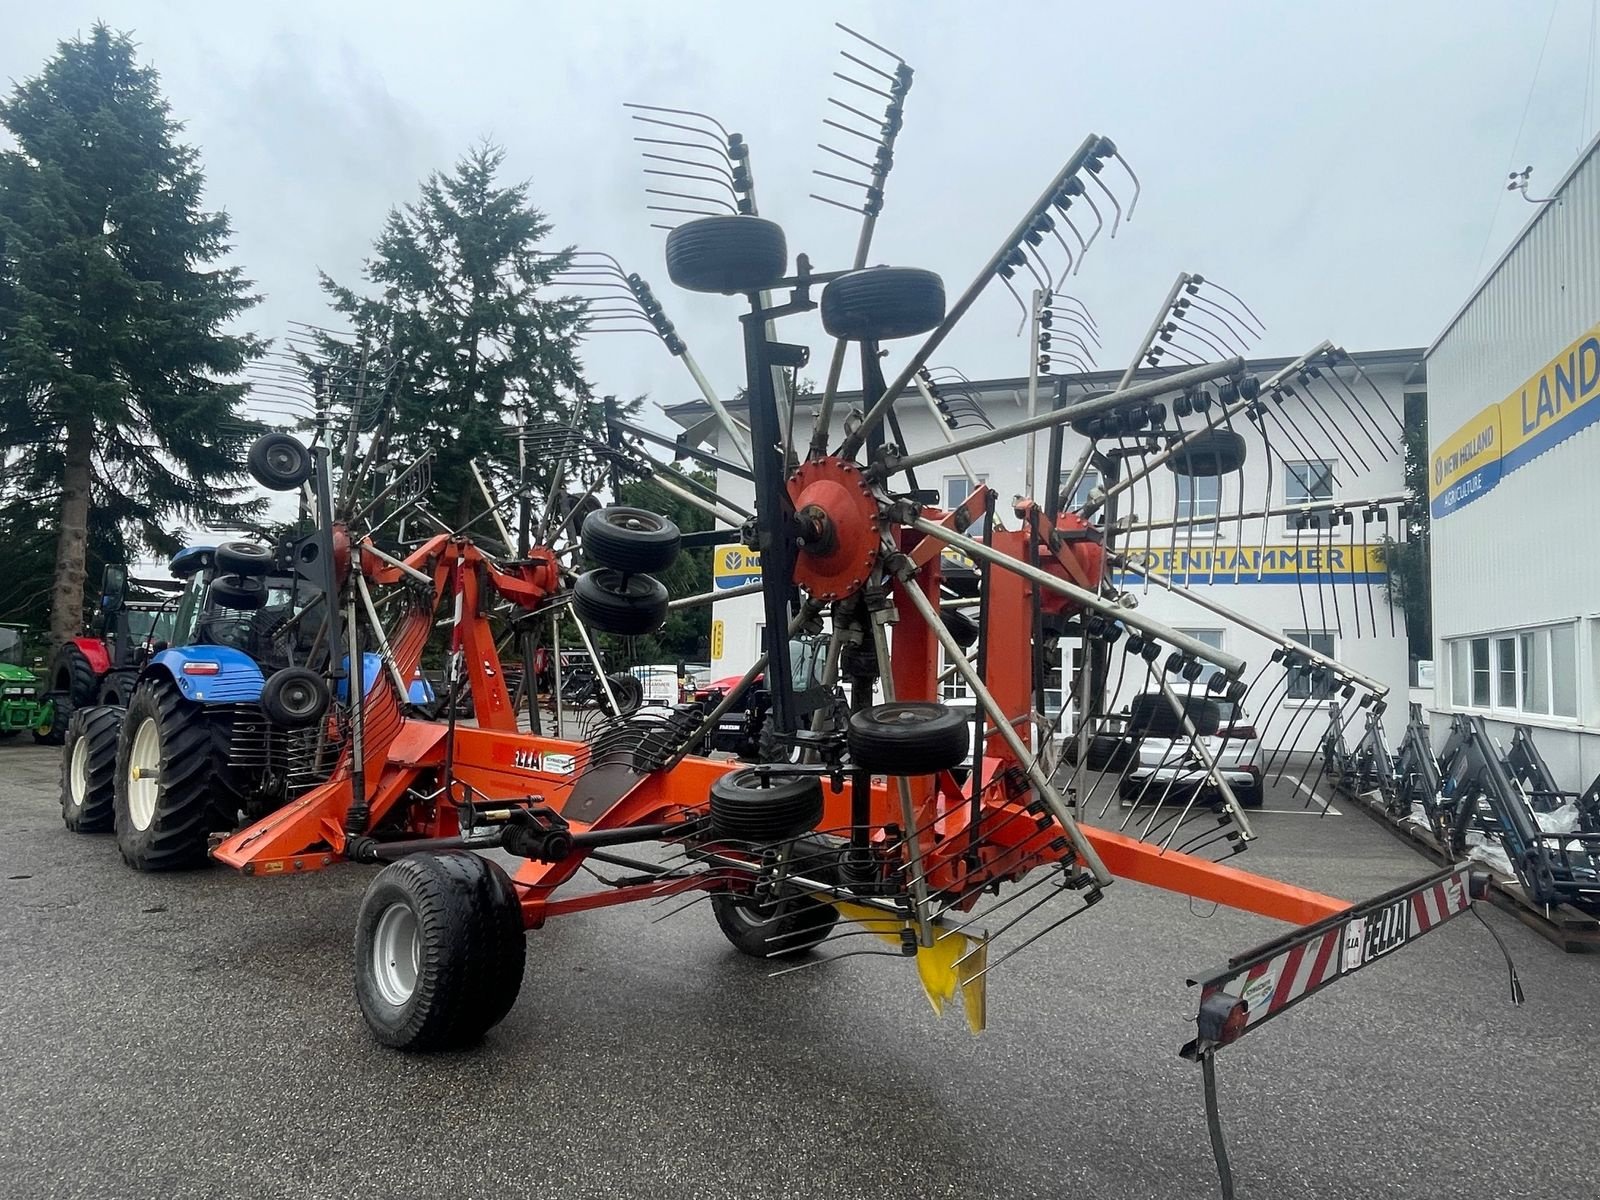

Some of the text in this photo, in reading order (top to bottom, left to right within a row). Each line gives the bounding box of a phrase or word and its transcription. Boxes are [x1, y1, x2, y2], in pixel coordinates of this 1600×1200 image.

[1521, 337, 1600, 436] LAND
[1443, 425, 1494, 477] NEW HOLLAND
[1444, 473, 1482, 508] AGRICULTURE
[1140, 549, 1345, 571] DENHAMMER
